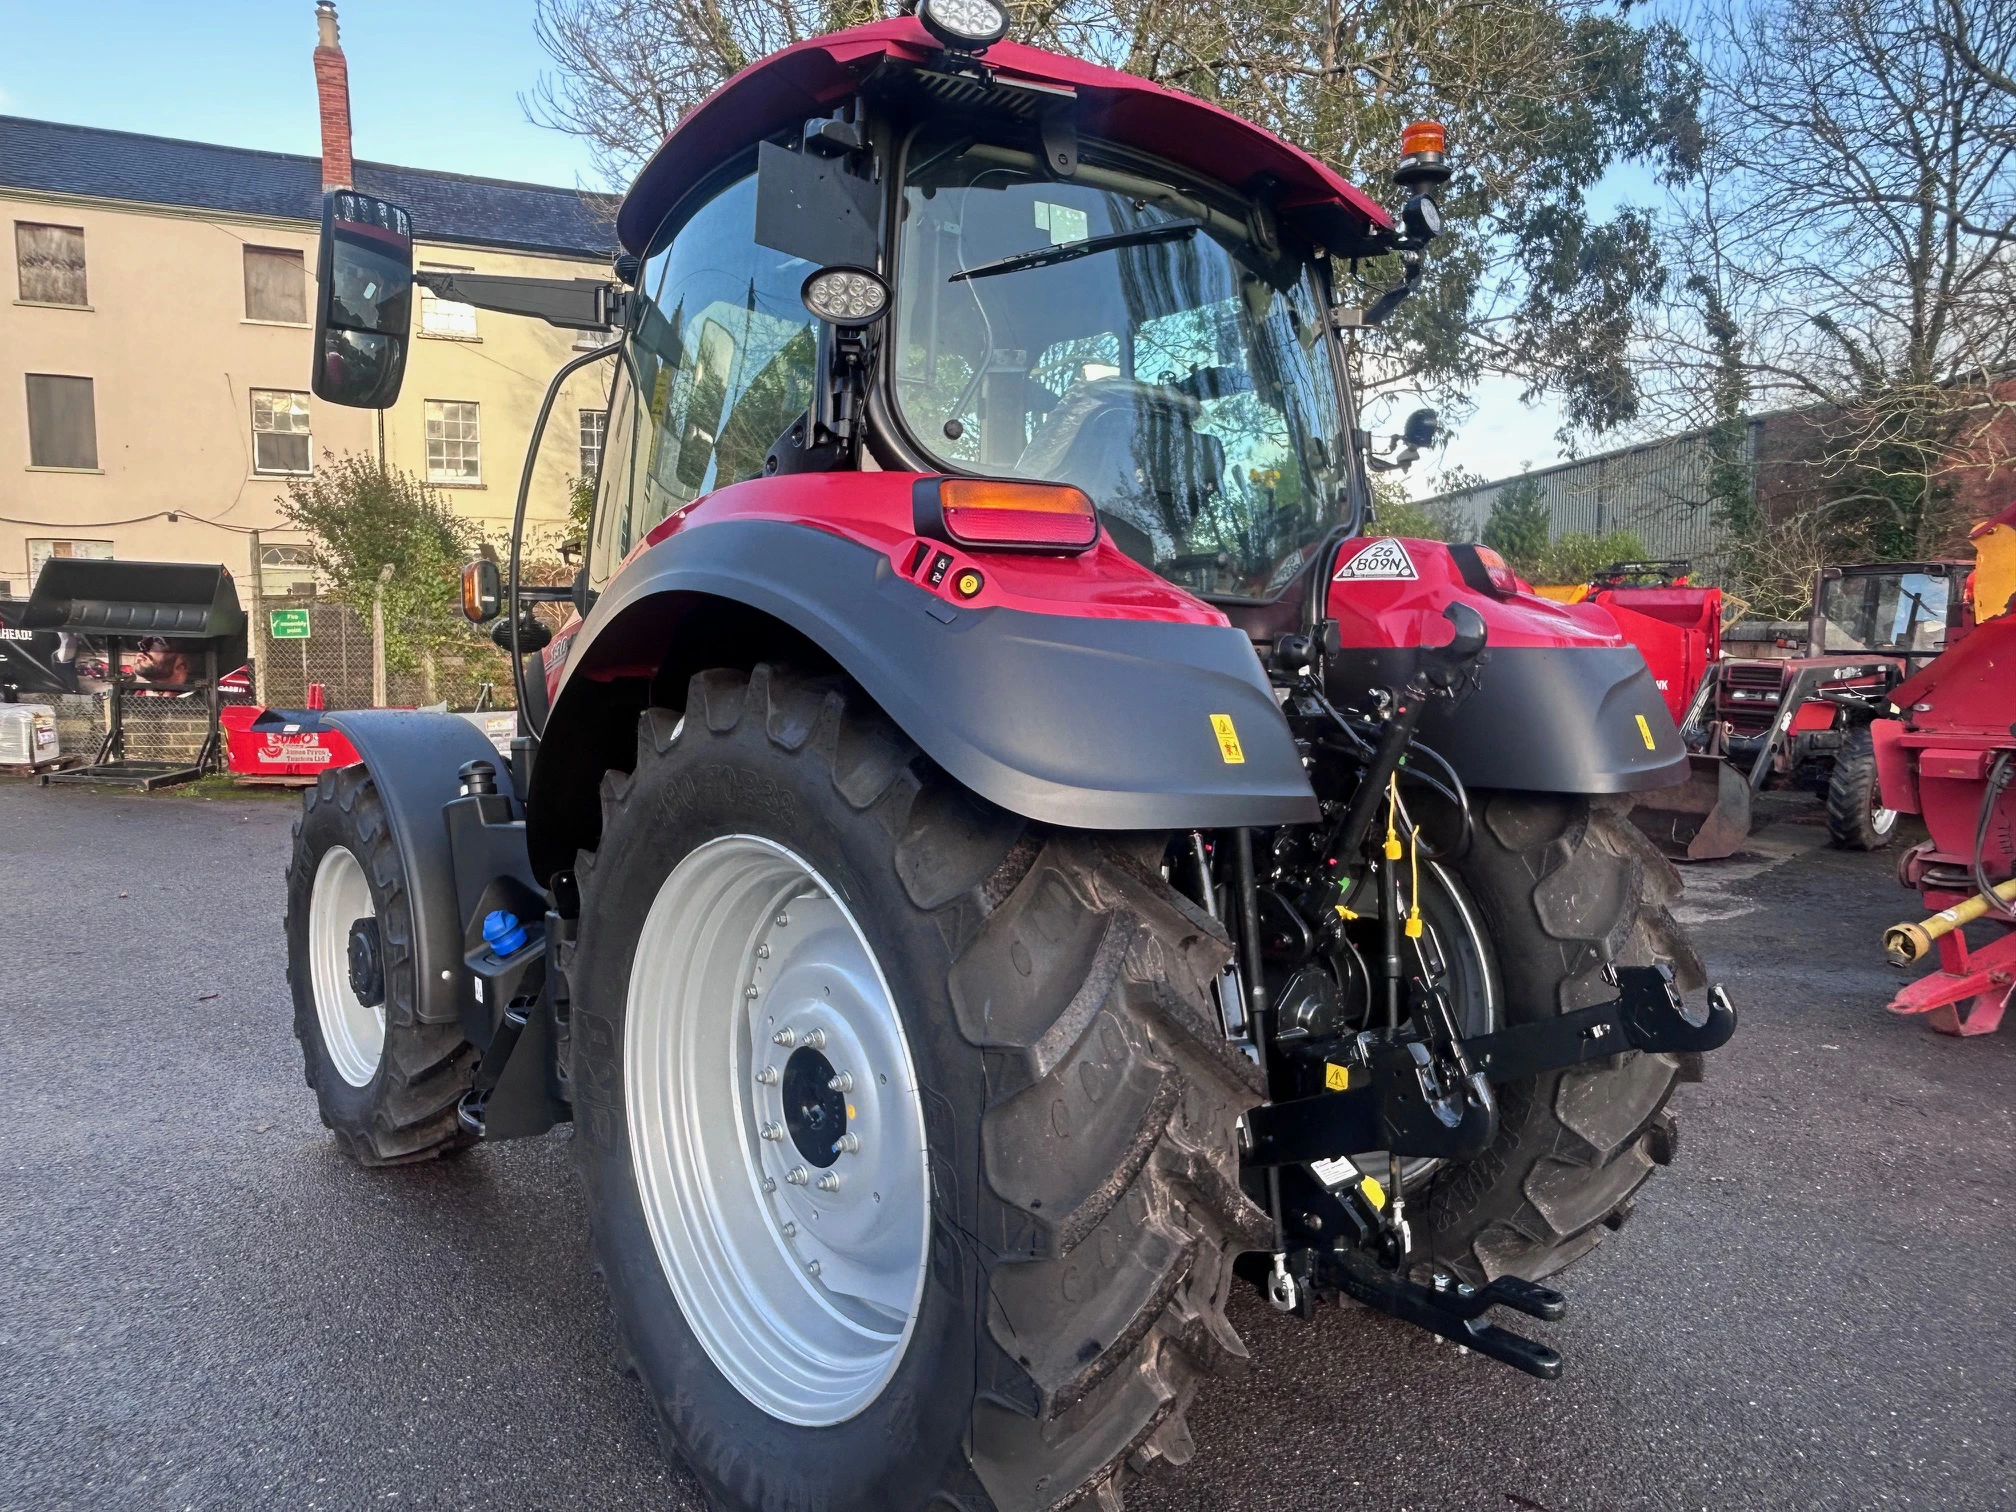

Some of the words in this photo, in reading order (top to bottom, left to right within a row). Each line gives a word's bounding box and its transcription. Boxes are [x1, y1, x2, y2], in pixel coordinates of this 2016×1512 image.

[1371, 546, 1394, 557] 26
[0, 628, 33, 641] HEAD!
[271, 733, 313, 744] SUMO
